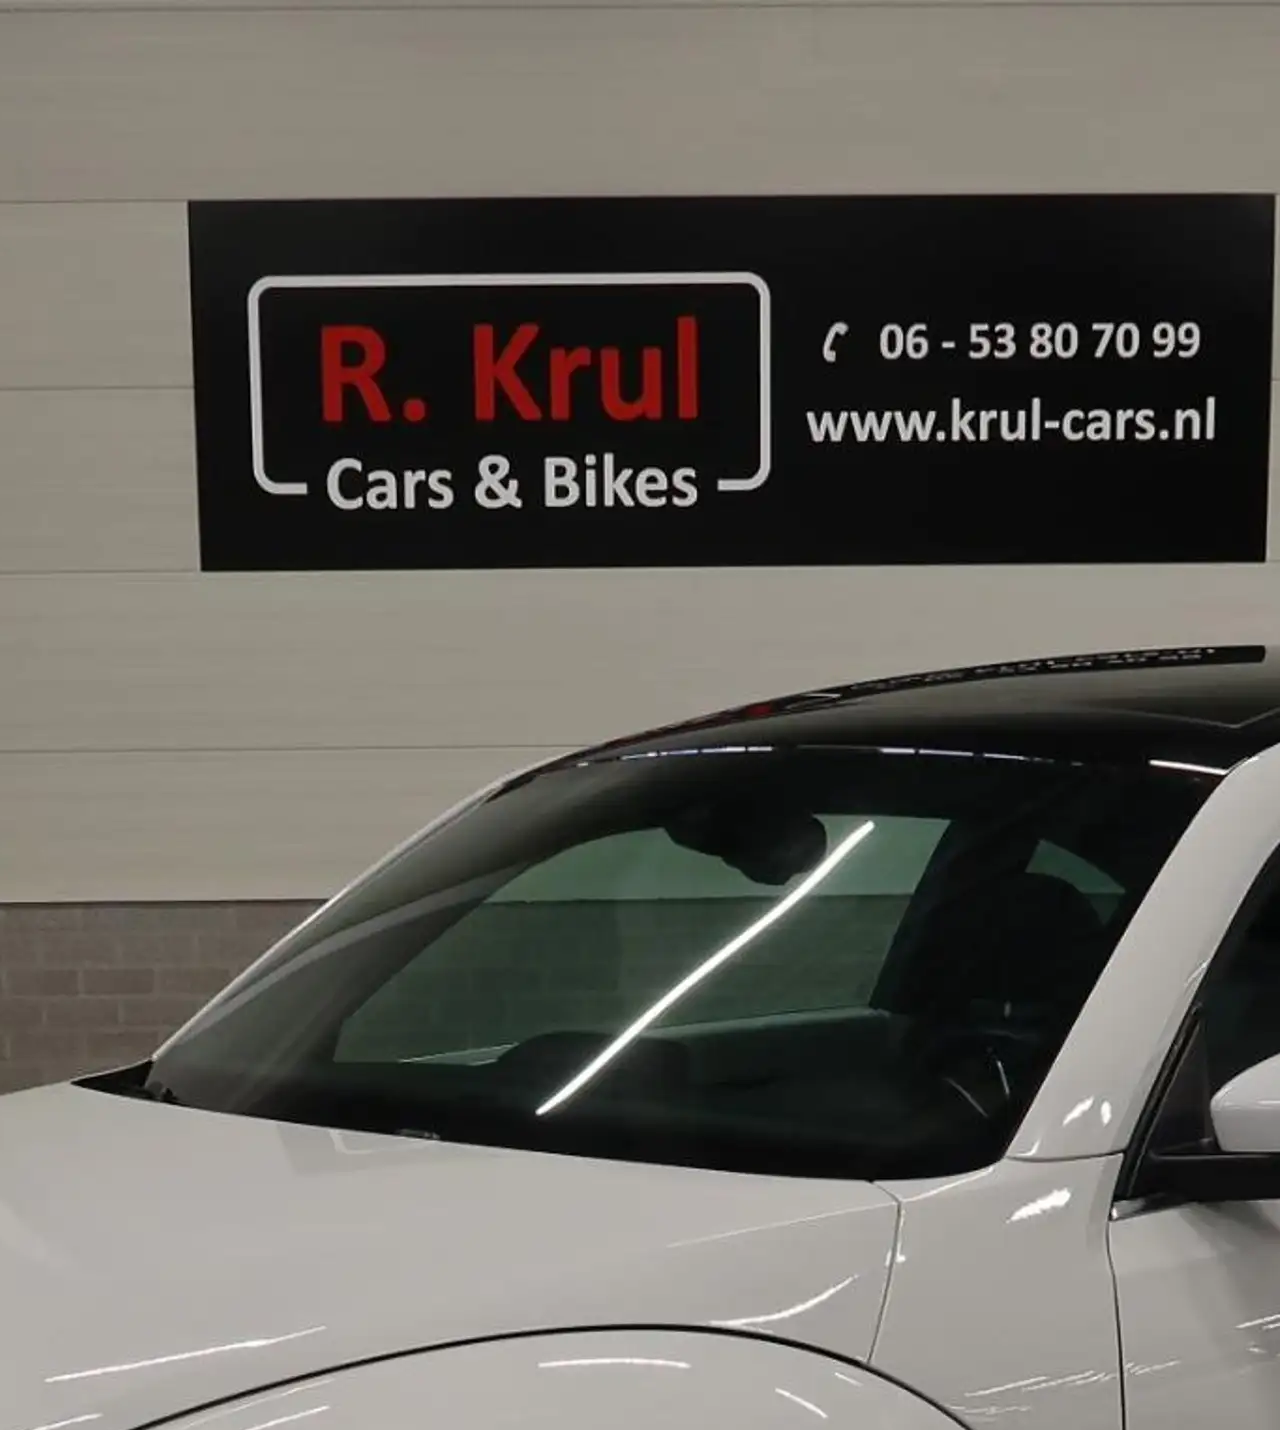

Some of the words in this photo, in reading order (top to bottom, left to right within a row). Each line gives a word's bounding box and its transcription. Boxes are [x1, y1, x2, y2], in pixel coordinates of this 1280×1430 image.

[879, 323, 929, 359] 06
[941, 340, 956, 349] -
[969, 323, 1017, 359] 53
[1029, 322, 1078, 358] 80
[1091, 322, 1140, 358] 70
[1152, 322, 1200, 358] 99
[320, 324, 428, 424] R.
[472, 315, 700, 422] Krul
[806, 396, 1215, 442] www.krul-cars.nl
[326, 457, 454, 510] Cars
[474, 454, 522, 509] &
[544, 452, 698, 507] Bikes
